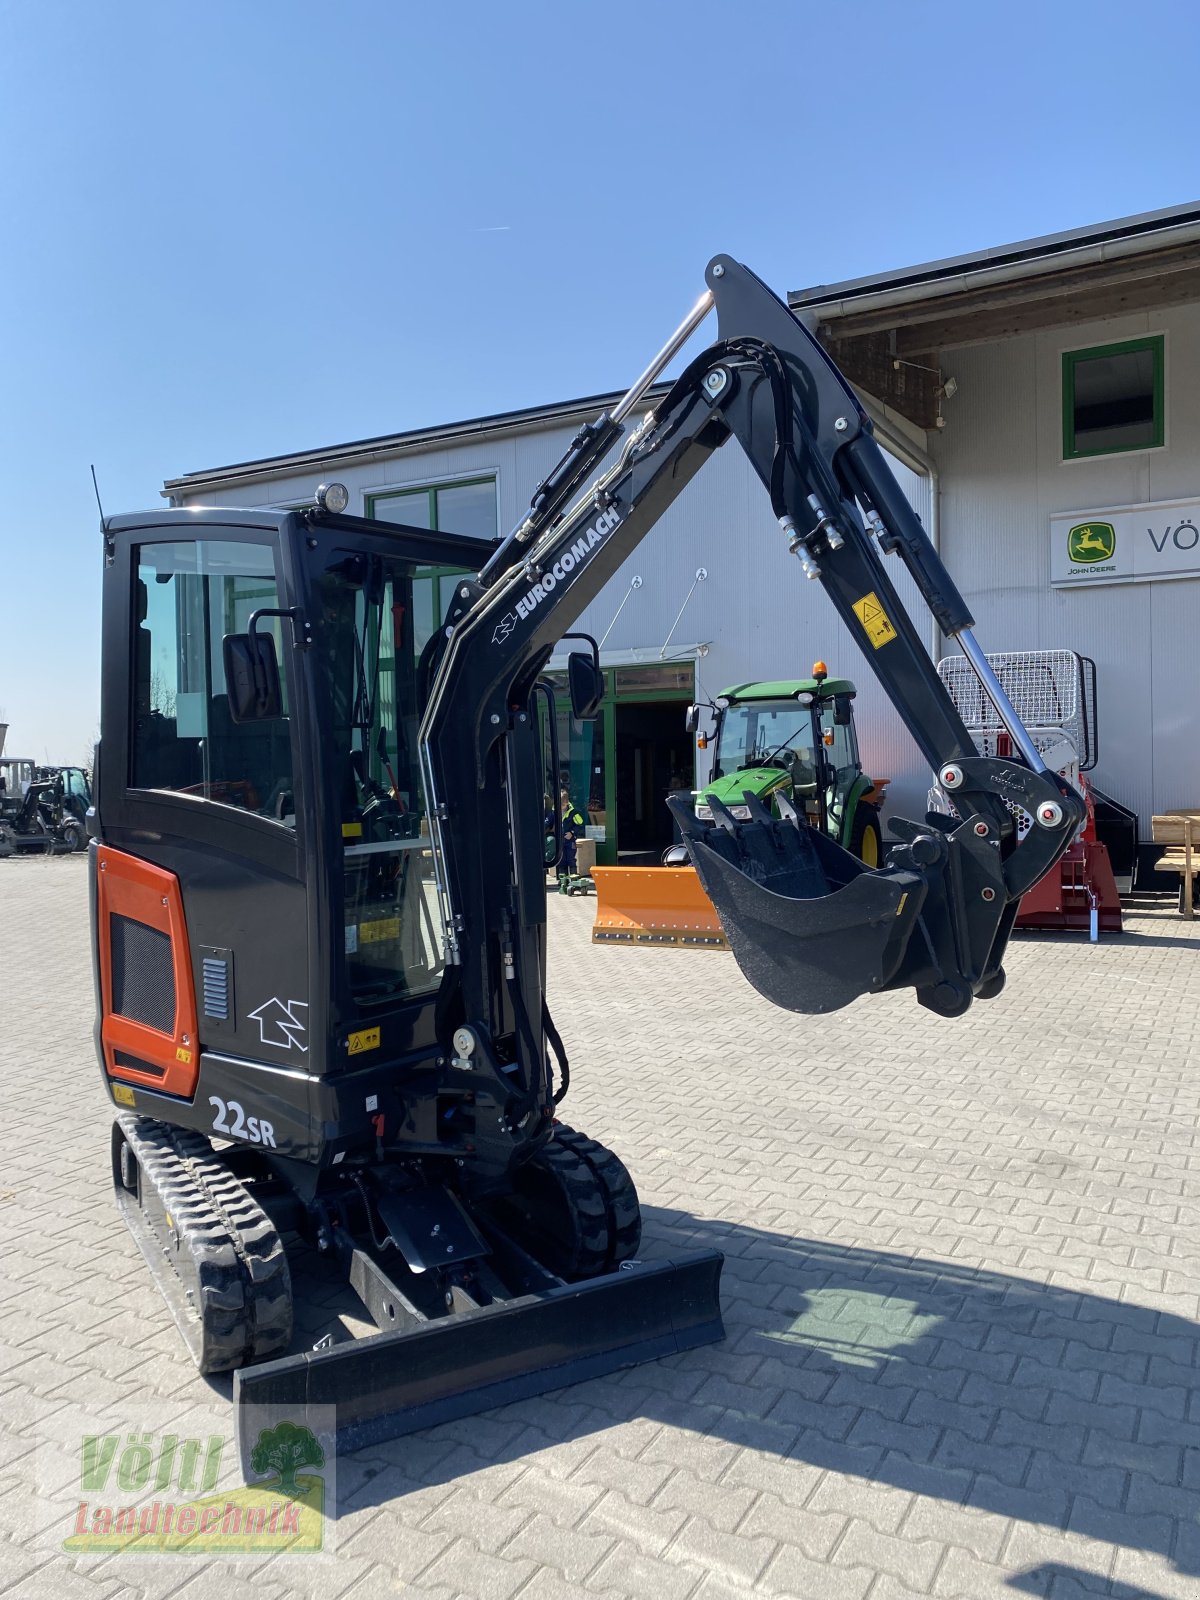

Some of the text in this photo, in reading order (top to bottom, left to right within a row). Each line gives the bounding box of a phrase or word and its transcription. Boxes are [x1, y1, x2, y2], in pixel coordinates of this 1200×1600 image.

[515, 506, 620, 620] EUROCOMACH
[1068, 565, 1117, 575] JOHN DEERE
